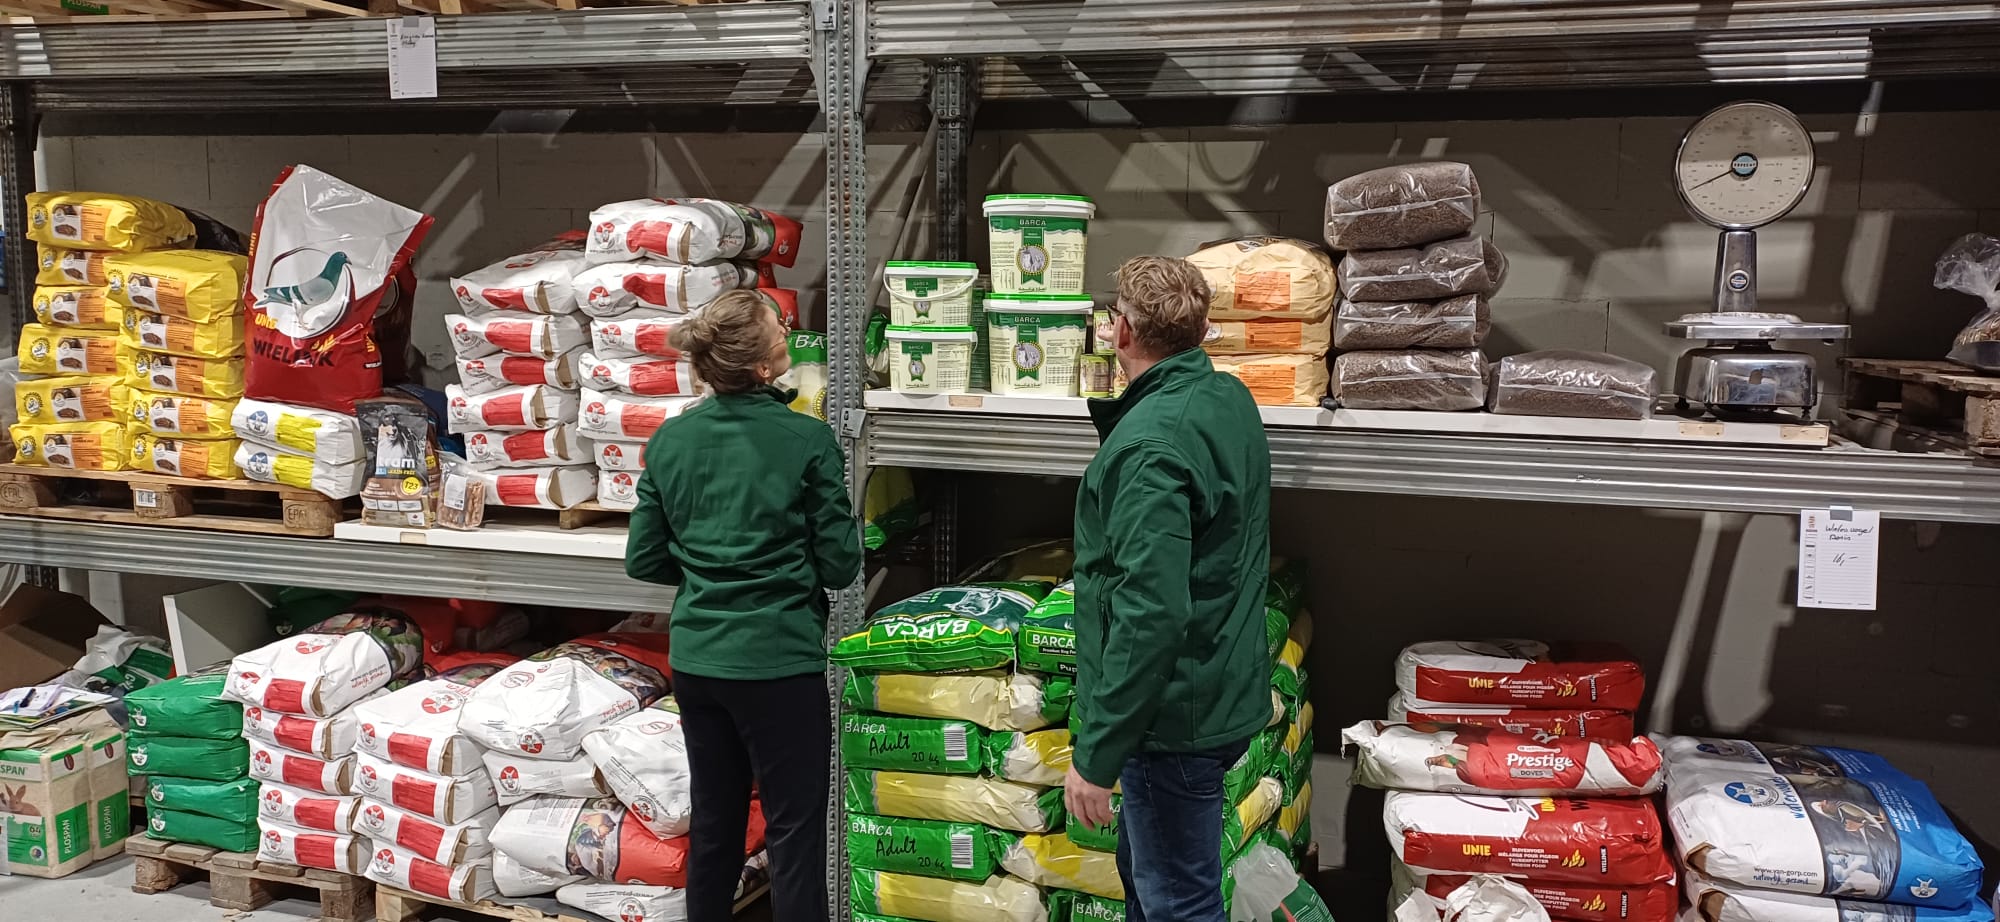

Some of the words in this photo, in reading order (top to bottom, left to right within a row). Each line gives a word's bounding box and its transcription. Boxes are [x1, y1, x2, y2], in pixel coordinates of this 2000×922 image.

[795, 334, 825, 349] BA
[884, 618, 971, 640] BARCA
[1032, 633, 1074, 649] BARCA
[1468, 677, 1495, 689] UNIE
[844, 722, 886, 734] BARCA
[869, 731, 911, 757] Adult
[911, 751, 925, 763] 20
[928, 752, 940, 766] kg
[1505, 753, 1574, 771] Prestige
[29, 824, 41, 834] 64
[104, 805, 113, 839] PLOSPAN
[852, 822, 893, 836] BARCA
[62, 819, 72, 854] PLOSPAN
[876, 835, 917, 858] Adult
[1462, 844, 1492, 856] UNIE
[917, 856, 931, 867] 20
[934, 858, 946, 871] kg
[1754, 866, 1818, 878] www.van-gorp.com
[1076, 902, 1122, 922] BARCA
